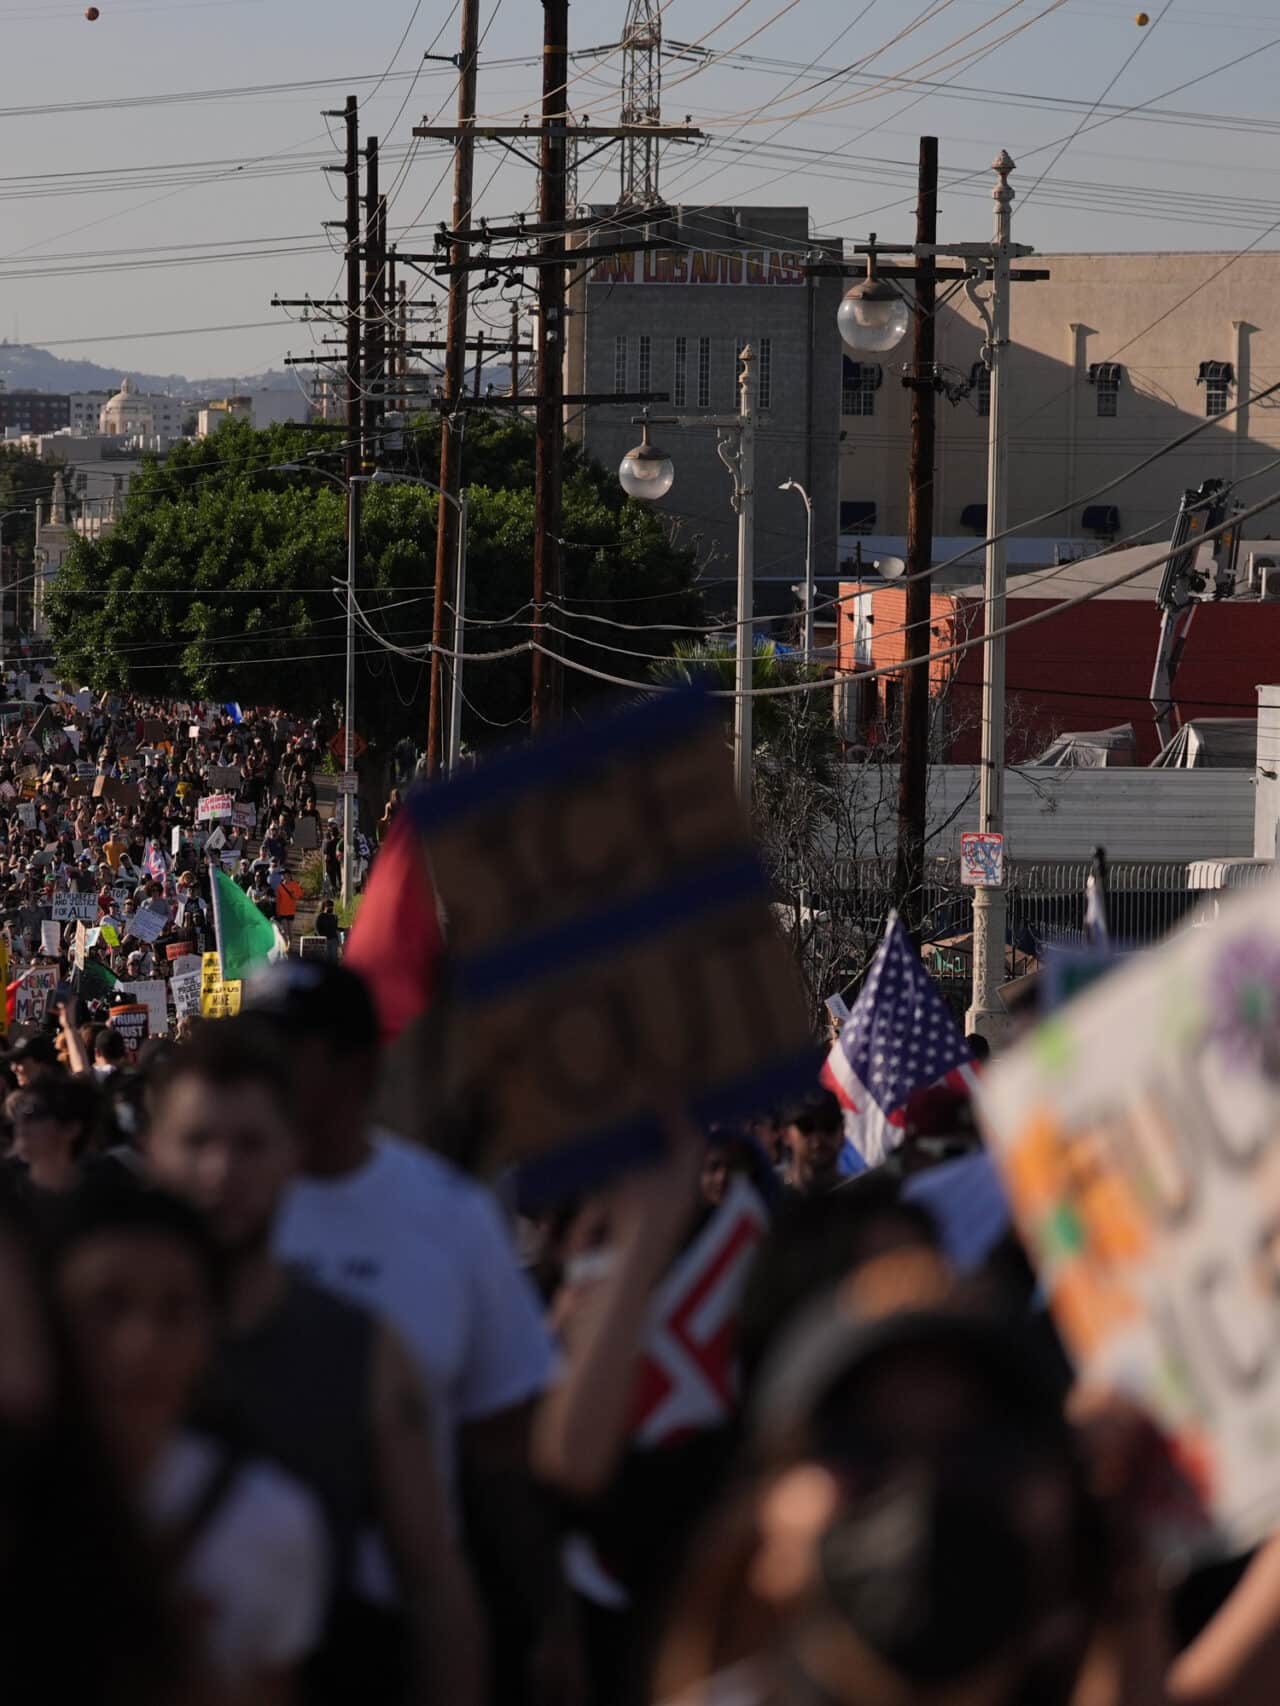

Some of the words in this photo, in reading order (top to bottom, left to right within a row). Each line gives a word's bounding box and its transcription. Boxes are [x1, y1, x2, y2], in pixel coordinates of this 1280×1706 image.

[691, 250, 743, 284] AUTO
[746, 252, 805, 285] GLASS
[68, 906, 91, 918] ALL
[31, 990, 43, 998] LA
